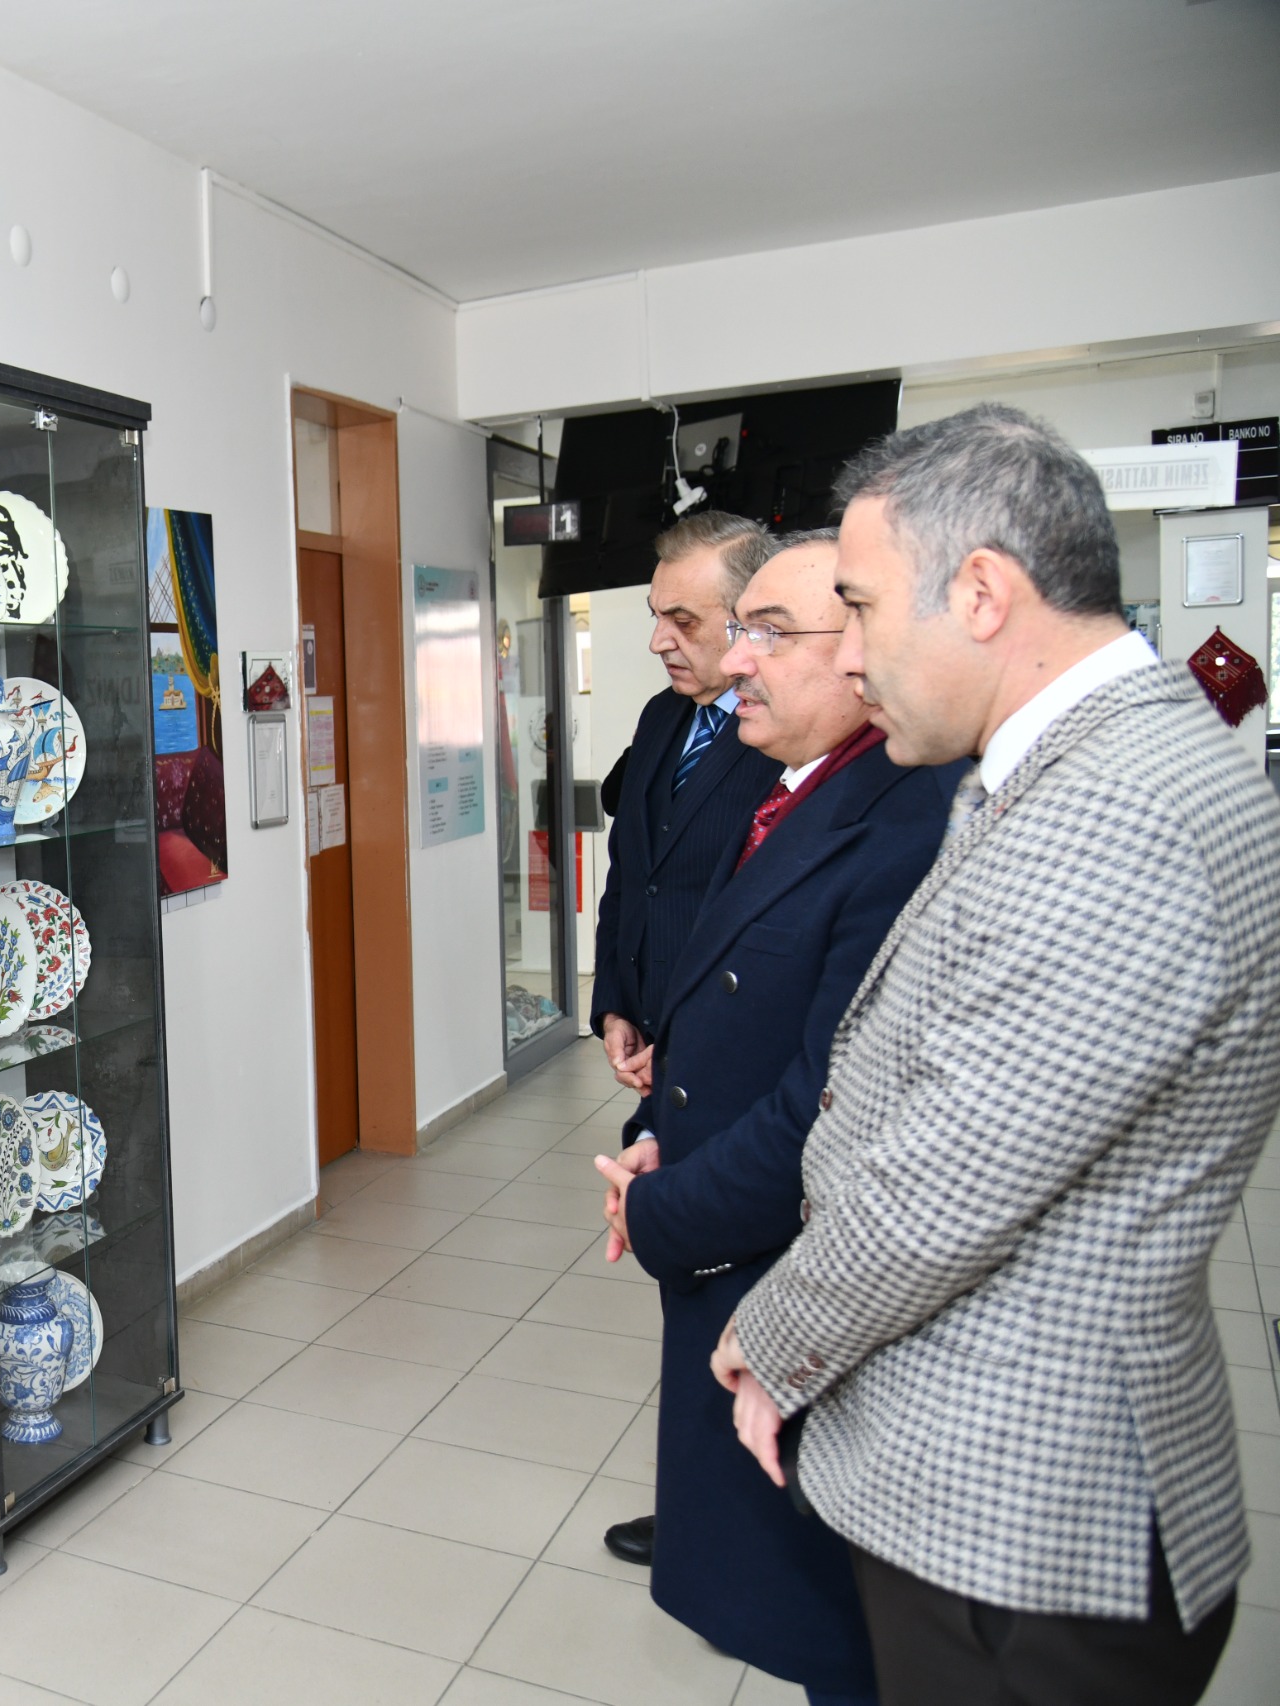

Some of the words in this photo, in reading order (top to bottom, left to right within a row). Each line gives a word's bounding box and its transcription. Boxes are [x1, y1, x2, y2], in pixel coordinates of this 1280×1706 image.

[1167, 434, 1187, 445] SIRA
[1190, 432, 1204, 442] NO
[1228, 427, 1257, 440] BANKO
[1258, 425, 1271, 437] NO
[560, 509, 572, 533] 1
